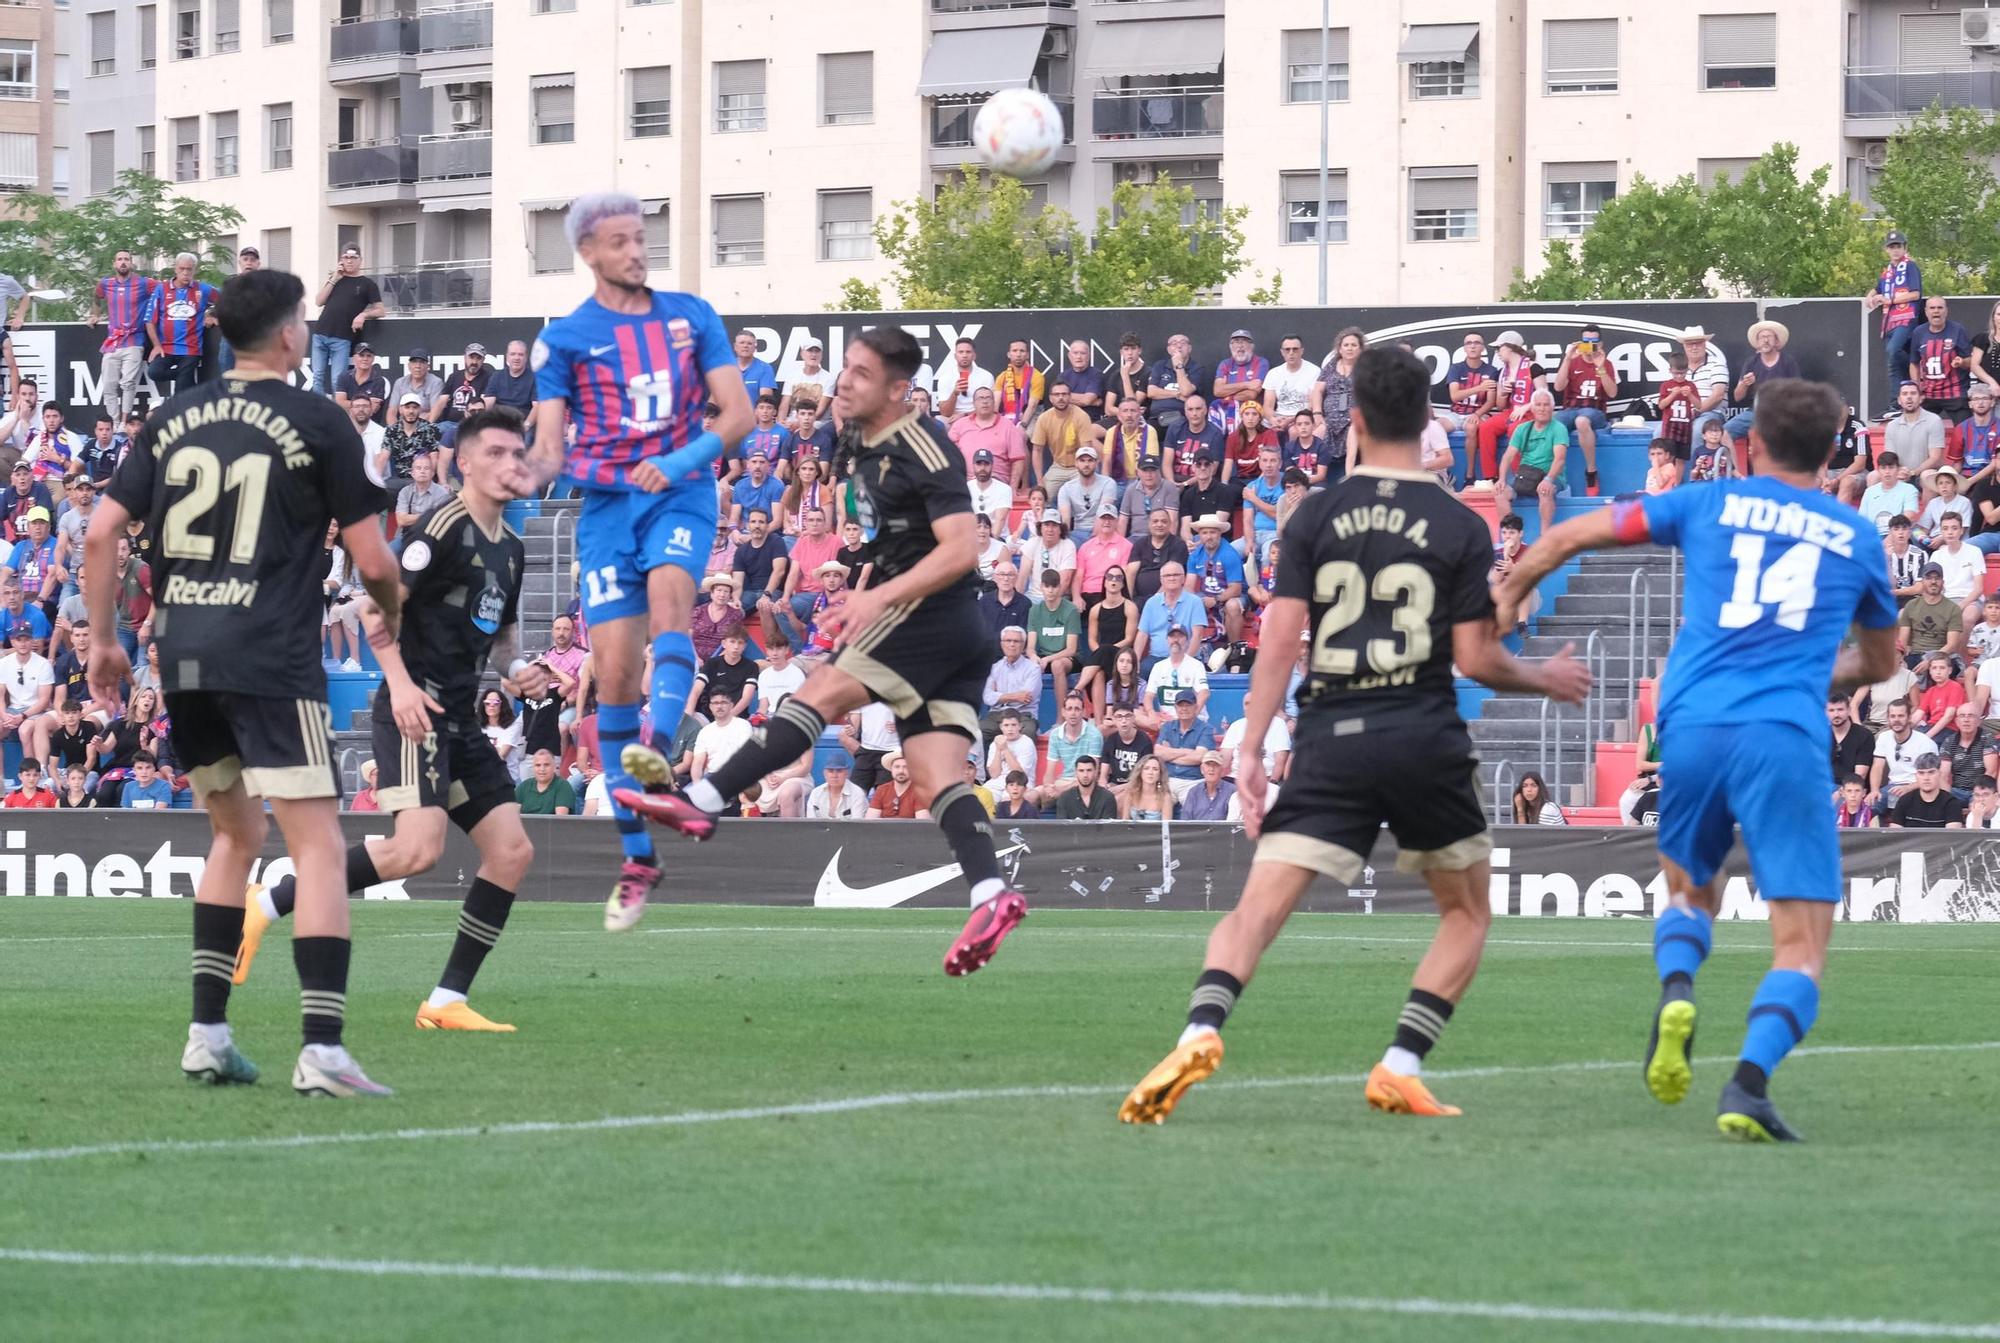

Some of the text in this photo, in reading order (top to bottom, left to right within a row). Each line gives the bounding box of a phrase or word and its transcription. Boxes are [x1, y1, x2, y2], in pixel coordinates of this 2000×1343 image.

[185, 397, 314, 470] BARTOLOME
[163, 446, 272, 564] 21
[1332, 504, 1429, 549] HUGO A.
[163, 574, 260, 607] Recalvi
[586, 565, 625, 608] 11
[1311, 560, 1436, 675] 23
[1718, 532, 1822, 632] 14
